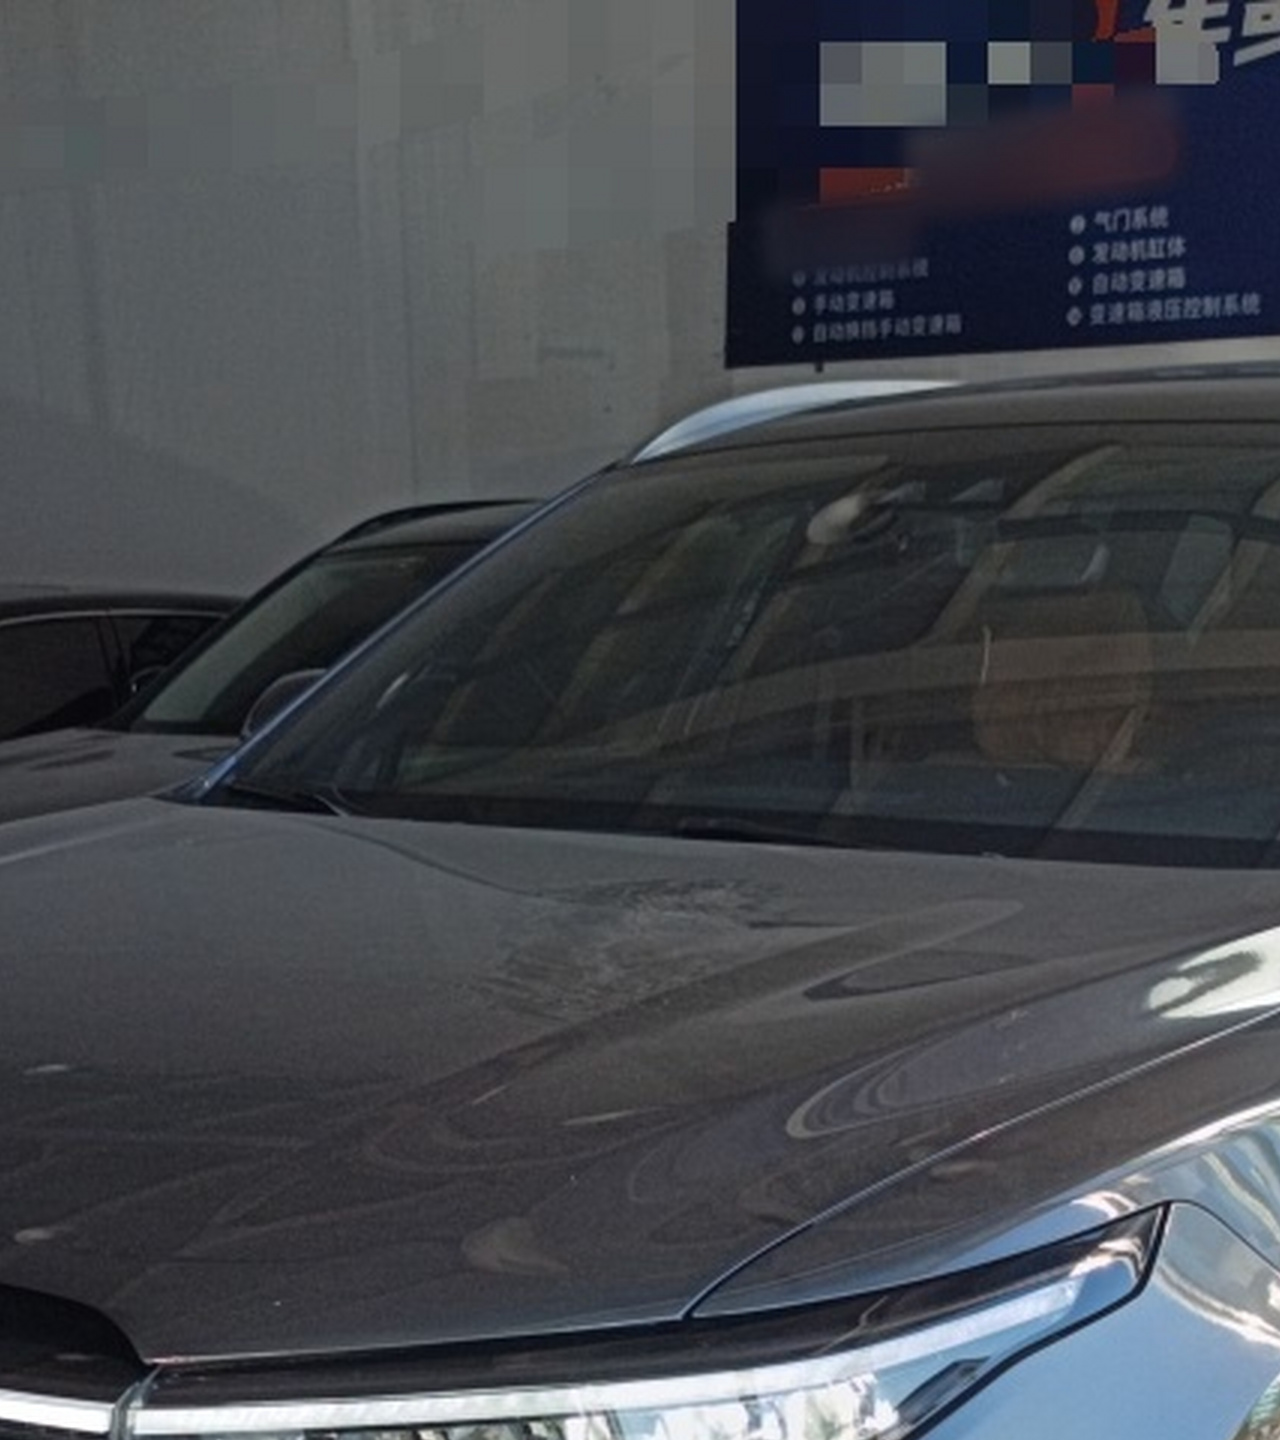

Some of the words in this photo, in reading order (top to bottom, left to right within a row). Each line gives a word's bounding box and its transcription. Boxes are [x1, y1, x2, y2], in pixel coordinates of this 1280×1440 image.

[1094, 206, 1169, 233] 气门系统
[1092, 236, 1187, 264] 发动机缸体
[1092, 267, 1186, 295] 自动变速箱
